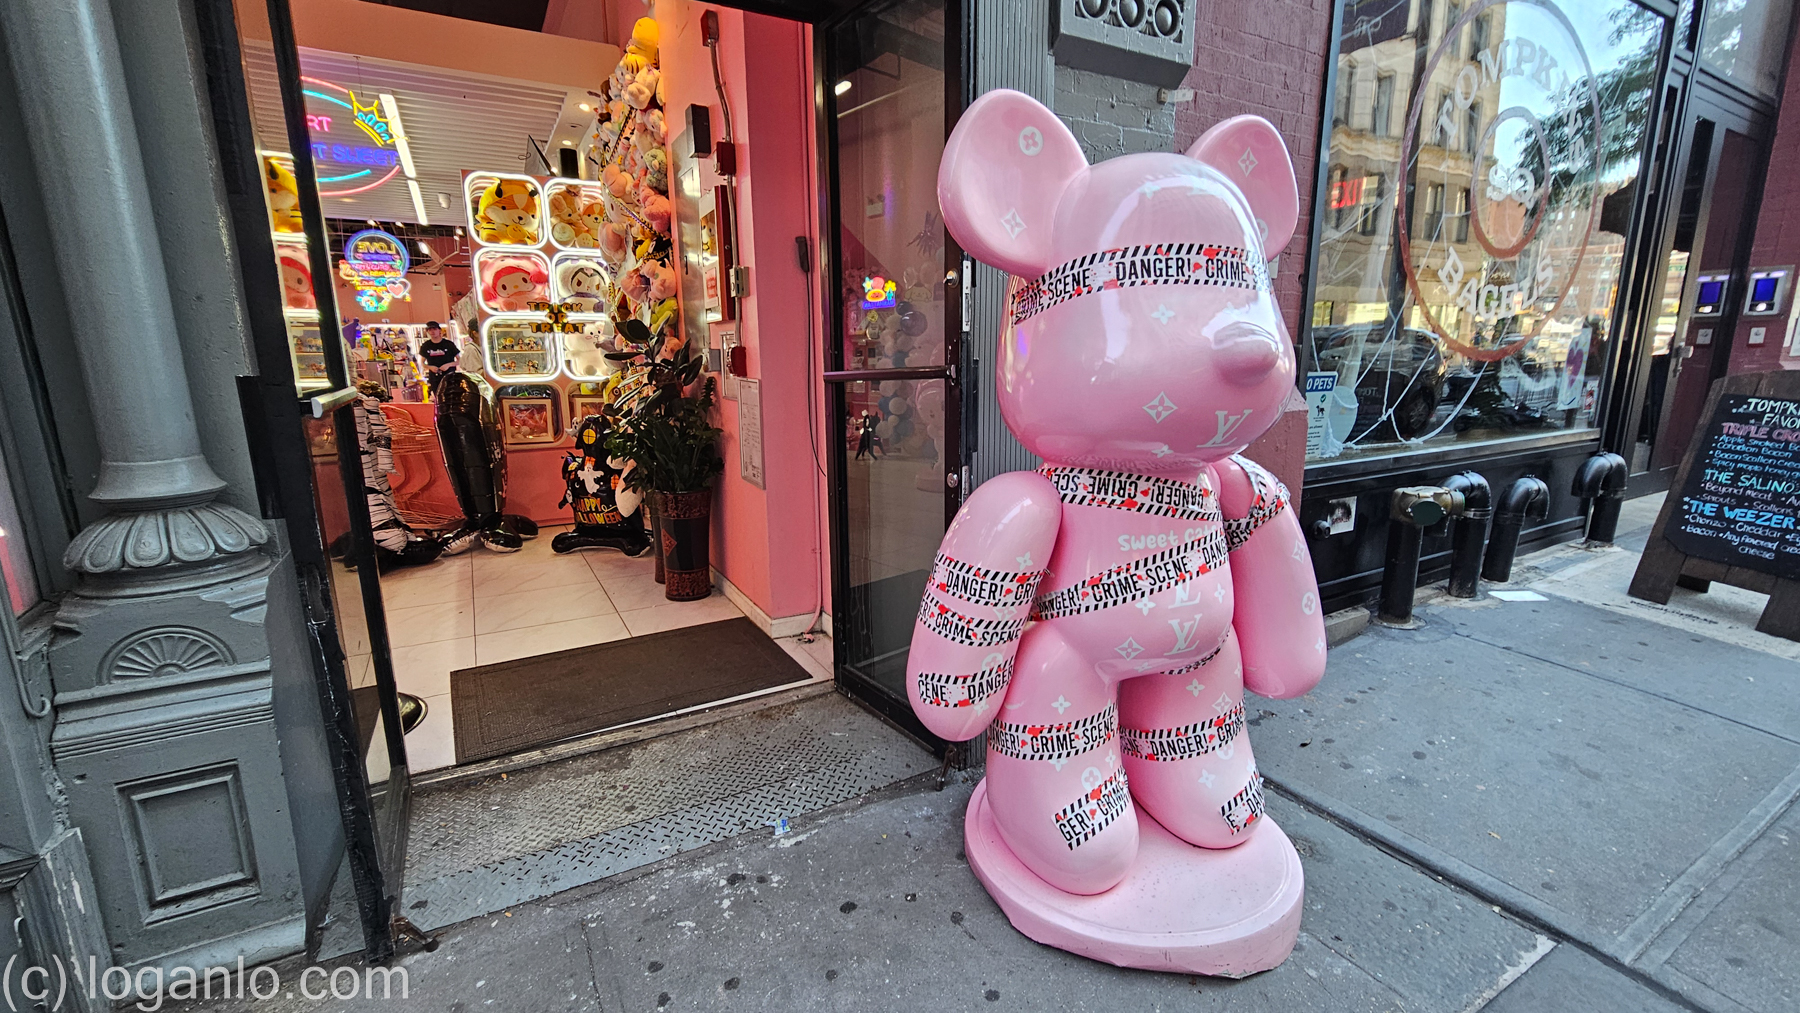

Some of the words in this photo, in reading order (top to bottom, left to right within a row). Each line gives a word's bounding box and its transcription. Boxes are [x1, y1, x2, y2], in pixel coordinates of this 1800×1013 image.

[332, 145, 399, 166] SWEET
[1047, 268, 1090, 301] SCENE
[1115, 257, 1192, 281] DANGER!
[1205, 257, 1248, 283] CRIME
[1437, 246, 1554, 320] BAGELS
[527, 302, 583, 312] TRICK
[528, 322, 585, 333] TREAT
[1313, 377, 1334, 390] PETS
[1747, 397, 1800, 416] TOMPK
[1719, 434, 1745, 444] Apple
[1721, 422, 1770, 439] TRIPLE
[1049, 473, 1079, 493] SCE
[1086, 476, 1139, 500] CRIME
[1704, 469, 1734, 484] THE
[1738, 474, 1800, 494] SALINO
[1705, 482, 1744, 495] Beyond
[1689, 499, 1719, 516] THE
[1723, 506, 1795, 529] WEEZER
[947, 570, 1004, 604] DANGER!
[1036, 588, 1082, 613] DANGER!
[1092, 573, 1142, 603] CRIME
[1146, 555, 1191, 587] SCENE
[935, 613, 975, 641] CRIME
[1030, 732, 1077, 754] CRIME
[1082, 714, 1115, 745] SCENE
[1149, 733, 1208, 757] DANGER!
[1059, 809, 1095, 842] GER!
